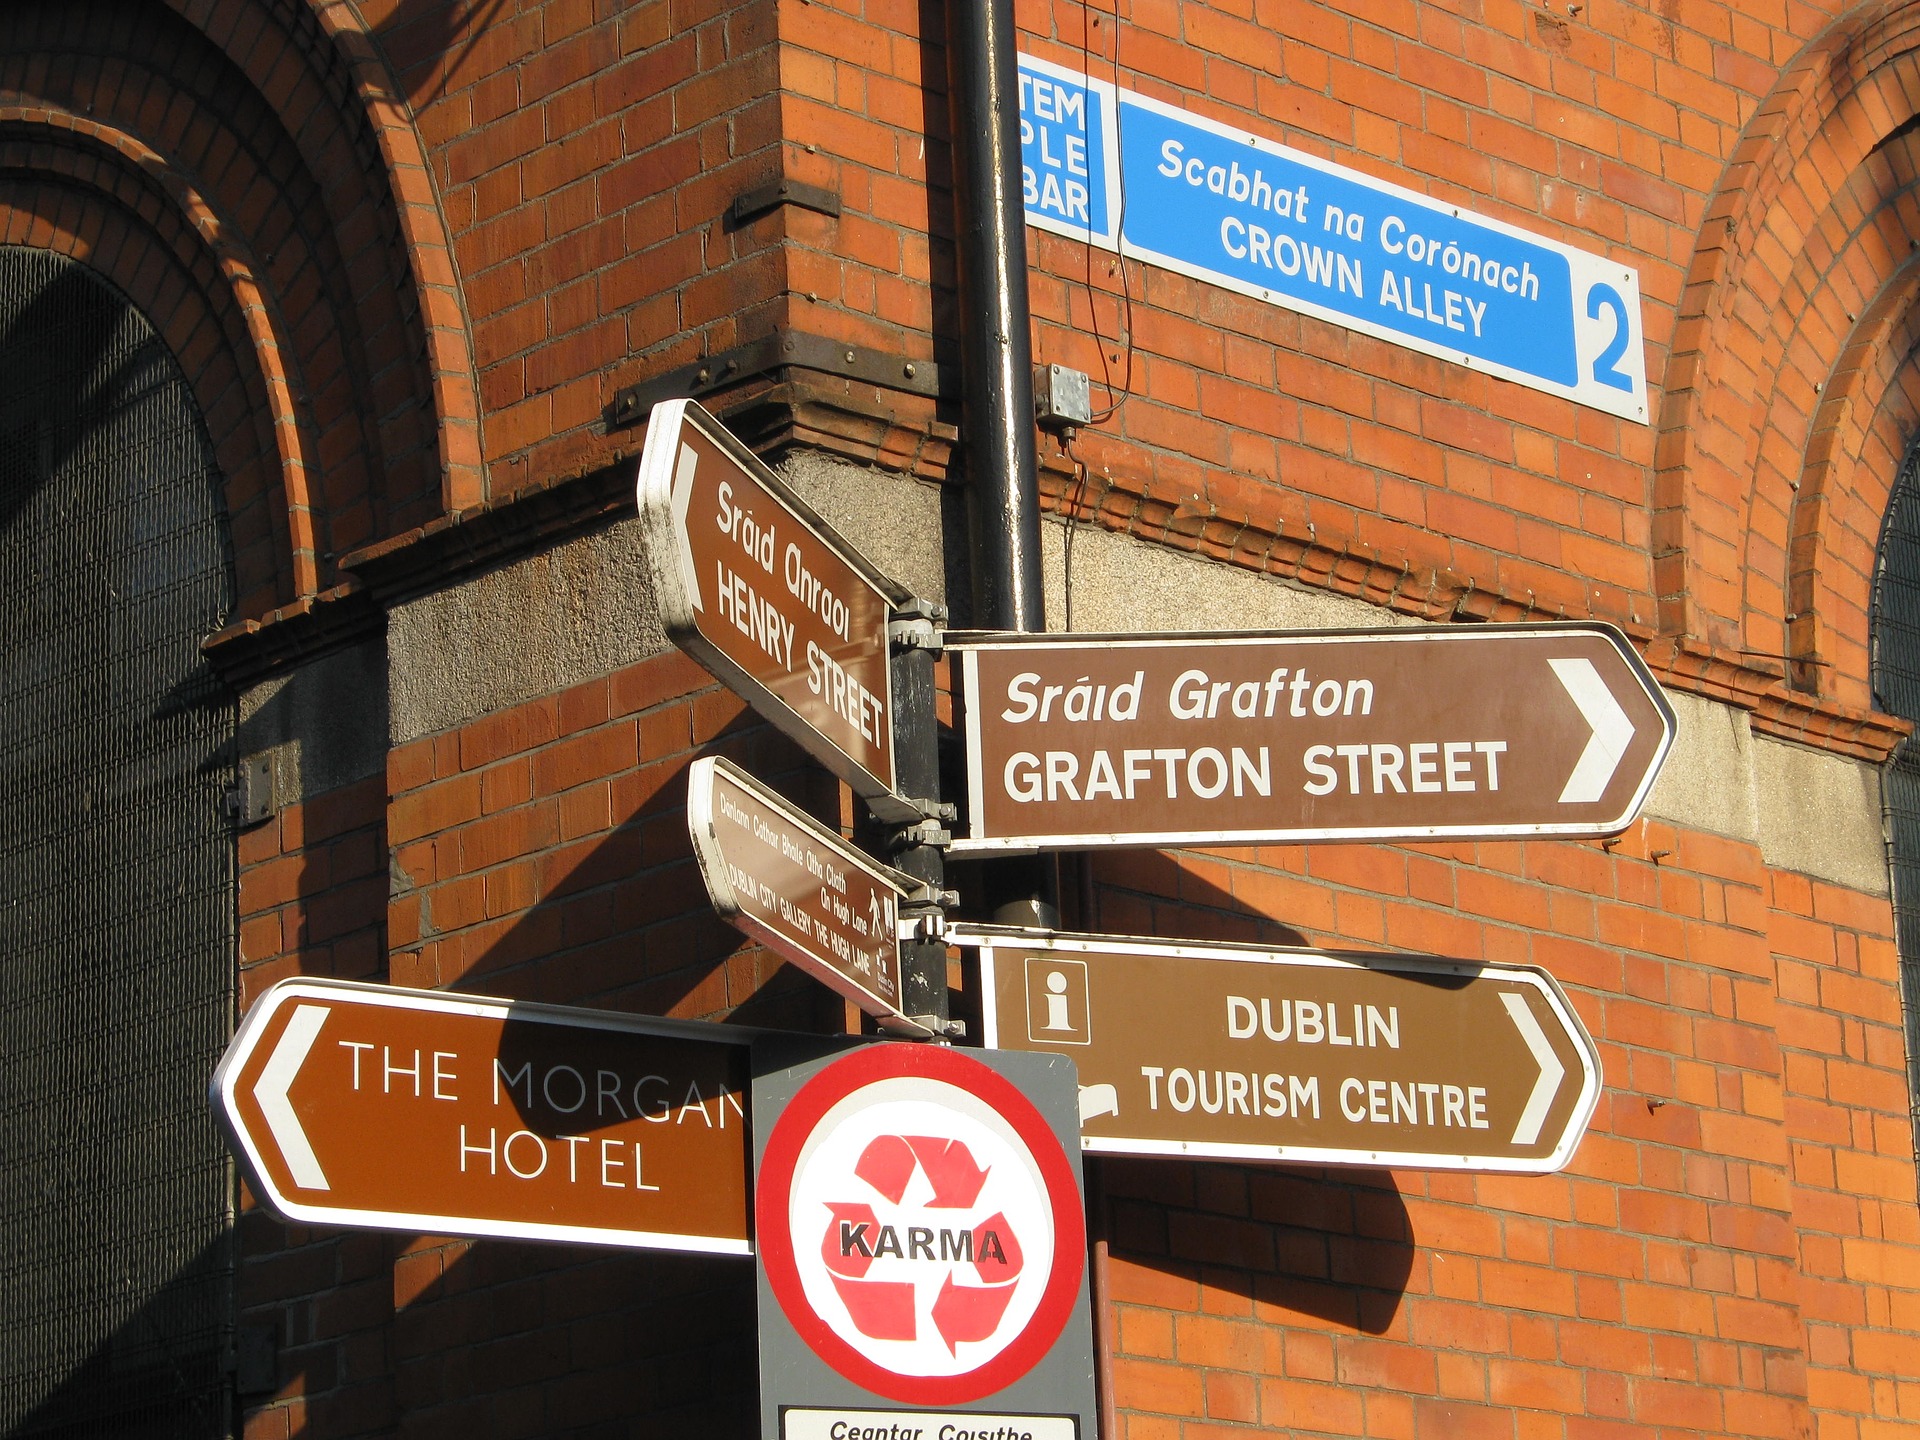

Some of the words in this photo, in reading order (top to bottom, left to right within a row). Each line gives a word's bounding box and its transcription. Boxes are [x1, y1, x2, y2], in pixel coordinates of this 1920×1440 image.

[1018, 72, 1086, 132] TEM
[1023, 164, 1090, 224] BAR
[1157, 138, 1310, 225] Scabhat
[1324, 203, 1365, 243] na
[1379, 215, 1541, 301] Corónach
[1219, 216, 1364, 300] CROWN
[1378, 269, 1488, 339] ALLEY
[1586, 282, 1634, 394] 2
[715, 480, 776, 575] Sráid
[716, 559, 796, 673] HENRY
[805, 639, 883, 750] STREET
[1001, 669, 1145, 724] Sráid
[1168, 666, 1374, 720] Grafton
[1003, 745, 1272, 803] GRAFTON
[1302, 740, 1508, 797] STREET
[728, 862, 758, 901] DUBLIN
[759, 882, 777, 914] CITY
[780, 896, 812, 937] GALLERY
[814, 918, 830, 949] THE
[830, 929, 851, 963] HUGH
[851, 944, 871, 977] LANE
[833, 894, 850, 926] Hugh
[852, 906, 868, 937] Lane
[1226, 995, 1400, 1049] DUBLIN
[338, 1040, 458, 1101] THE
[493, 1057, 747, 1130] MORGAN
[1141, 1066, 1320, 1120] TOURISM
[1338, 1076, 1491, 1130] CENTRE
[459, 1124, 660, 1192] HOTEL
[840, 1222, 1009, 1265] KARMA
[829, 1420, 923, 1440] Ceantar
